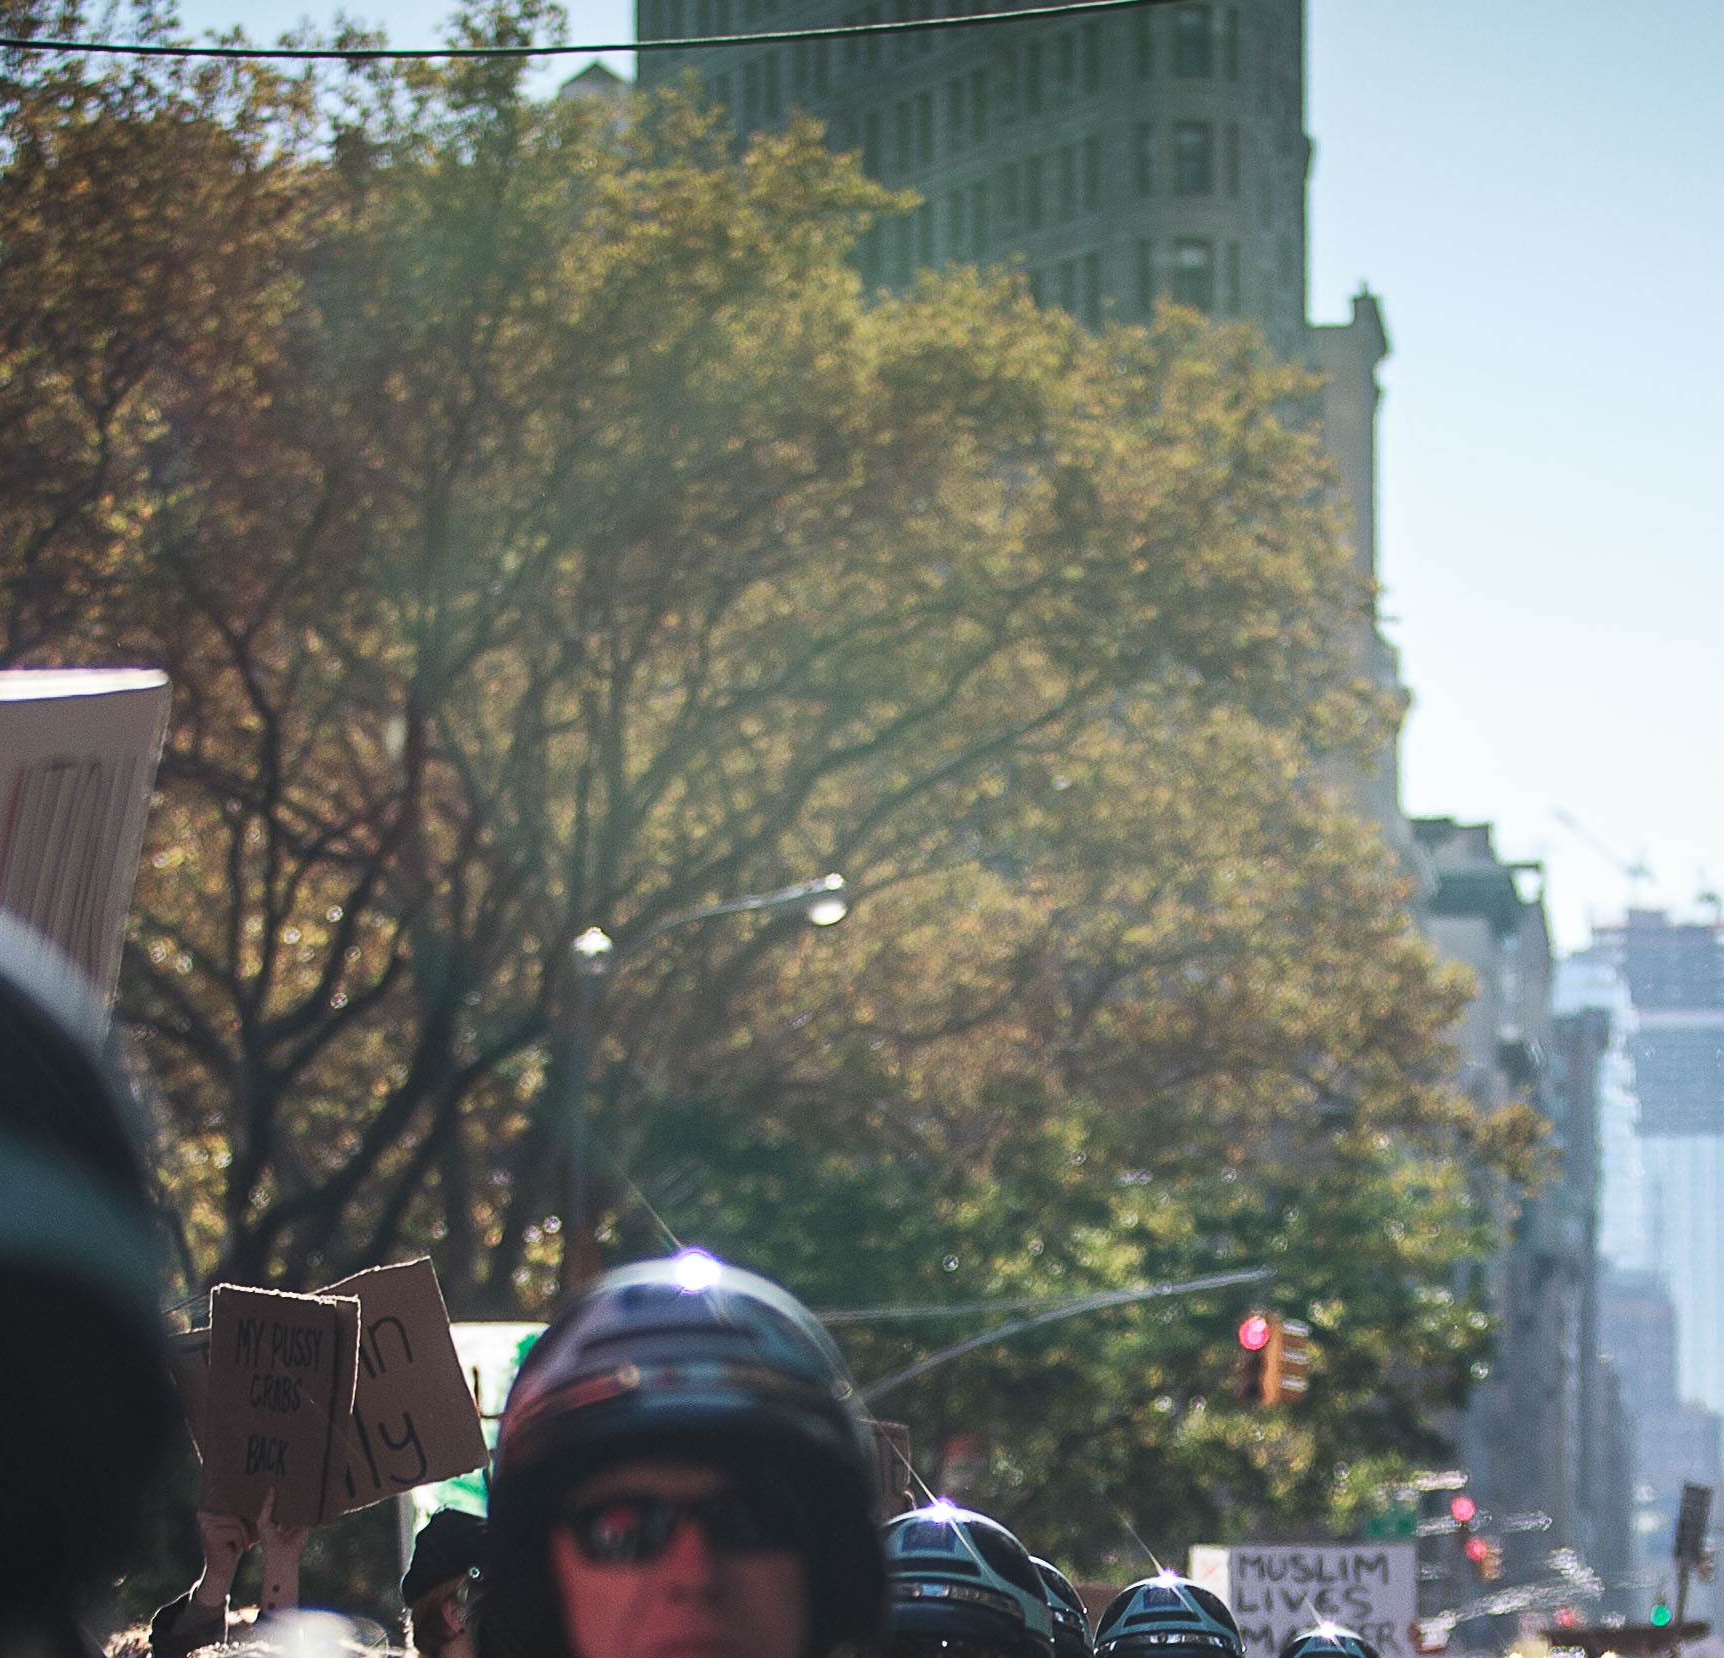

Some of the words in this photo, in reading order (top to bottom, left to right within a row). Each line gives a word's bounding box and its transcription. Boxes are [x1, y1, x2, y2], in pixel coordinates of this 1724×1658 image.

[235, 1318, 266, 1369] MY
[271, 1322, 323, 1372] PUSSY
[244, 1432, 290, 1476] BACK
[1238, 1552, 1390, 1585] MUSLIM
[1237, 1584, 1374, 1619] LIVES
